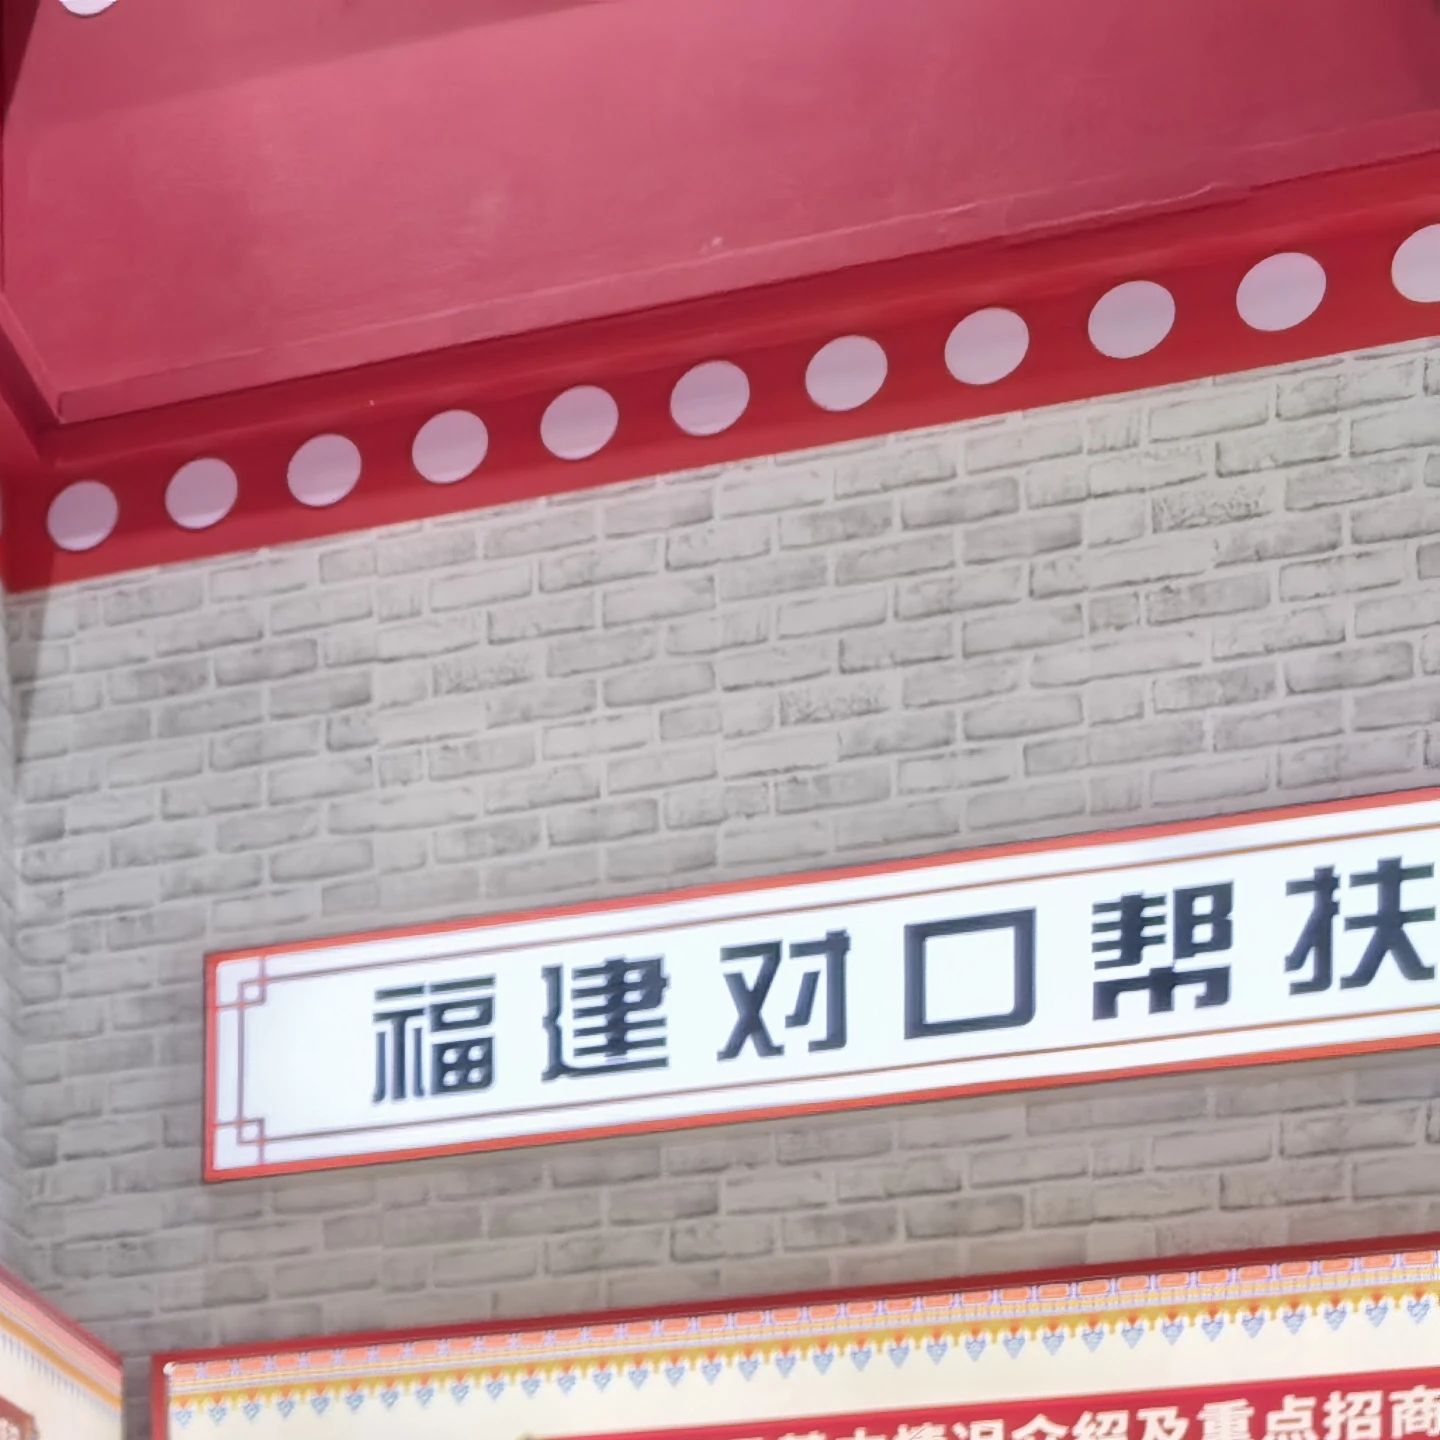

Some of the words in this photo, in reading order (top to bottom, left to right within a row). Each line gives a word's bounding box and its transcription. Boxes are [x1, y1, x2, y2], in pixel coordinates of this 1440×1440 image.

[371, 854, 1436, 1104] 福建对口帮扶
